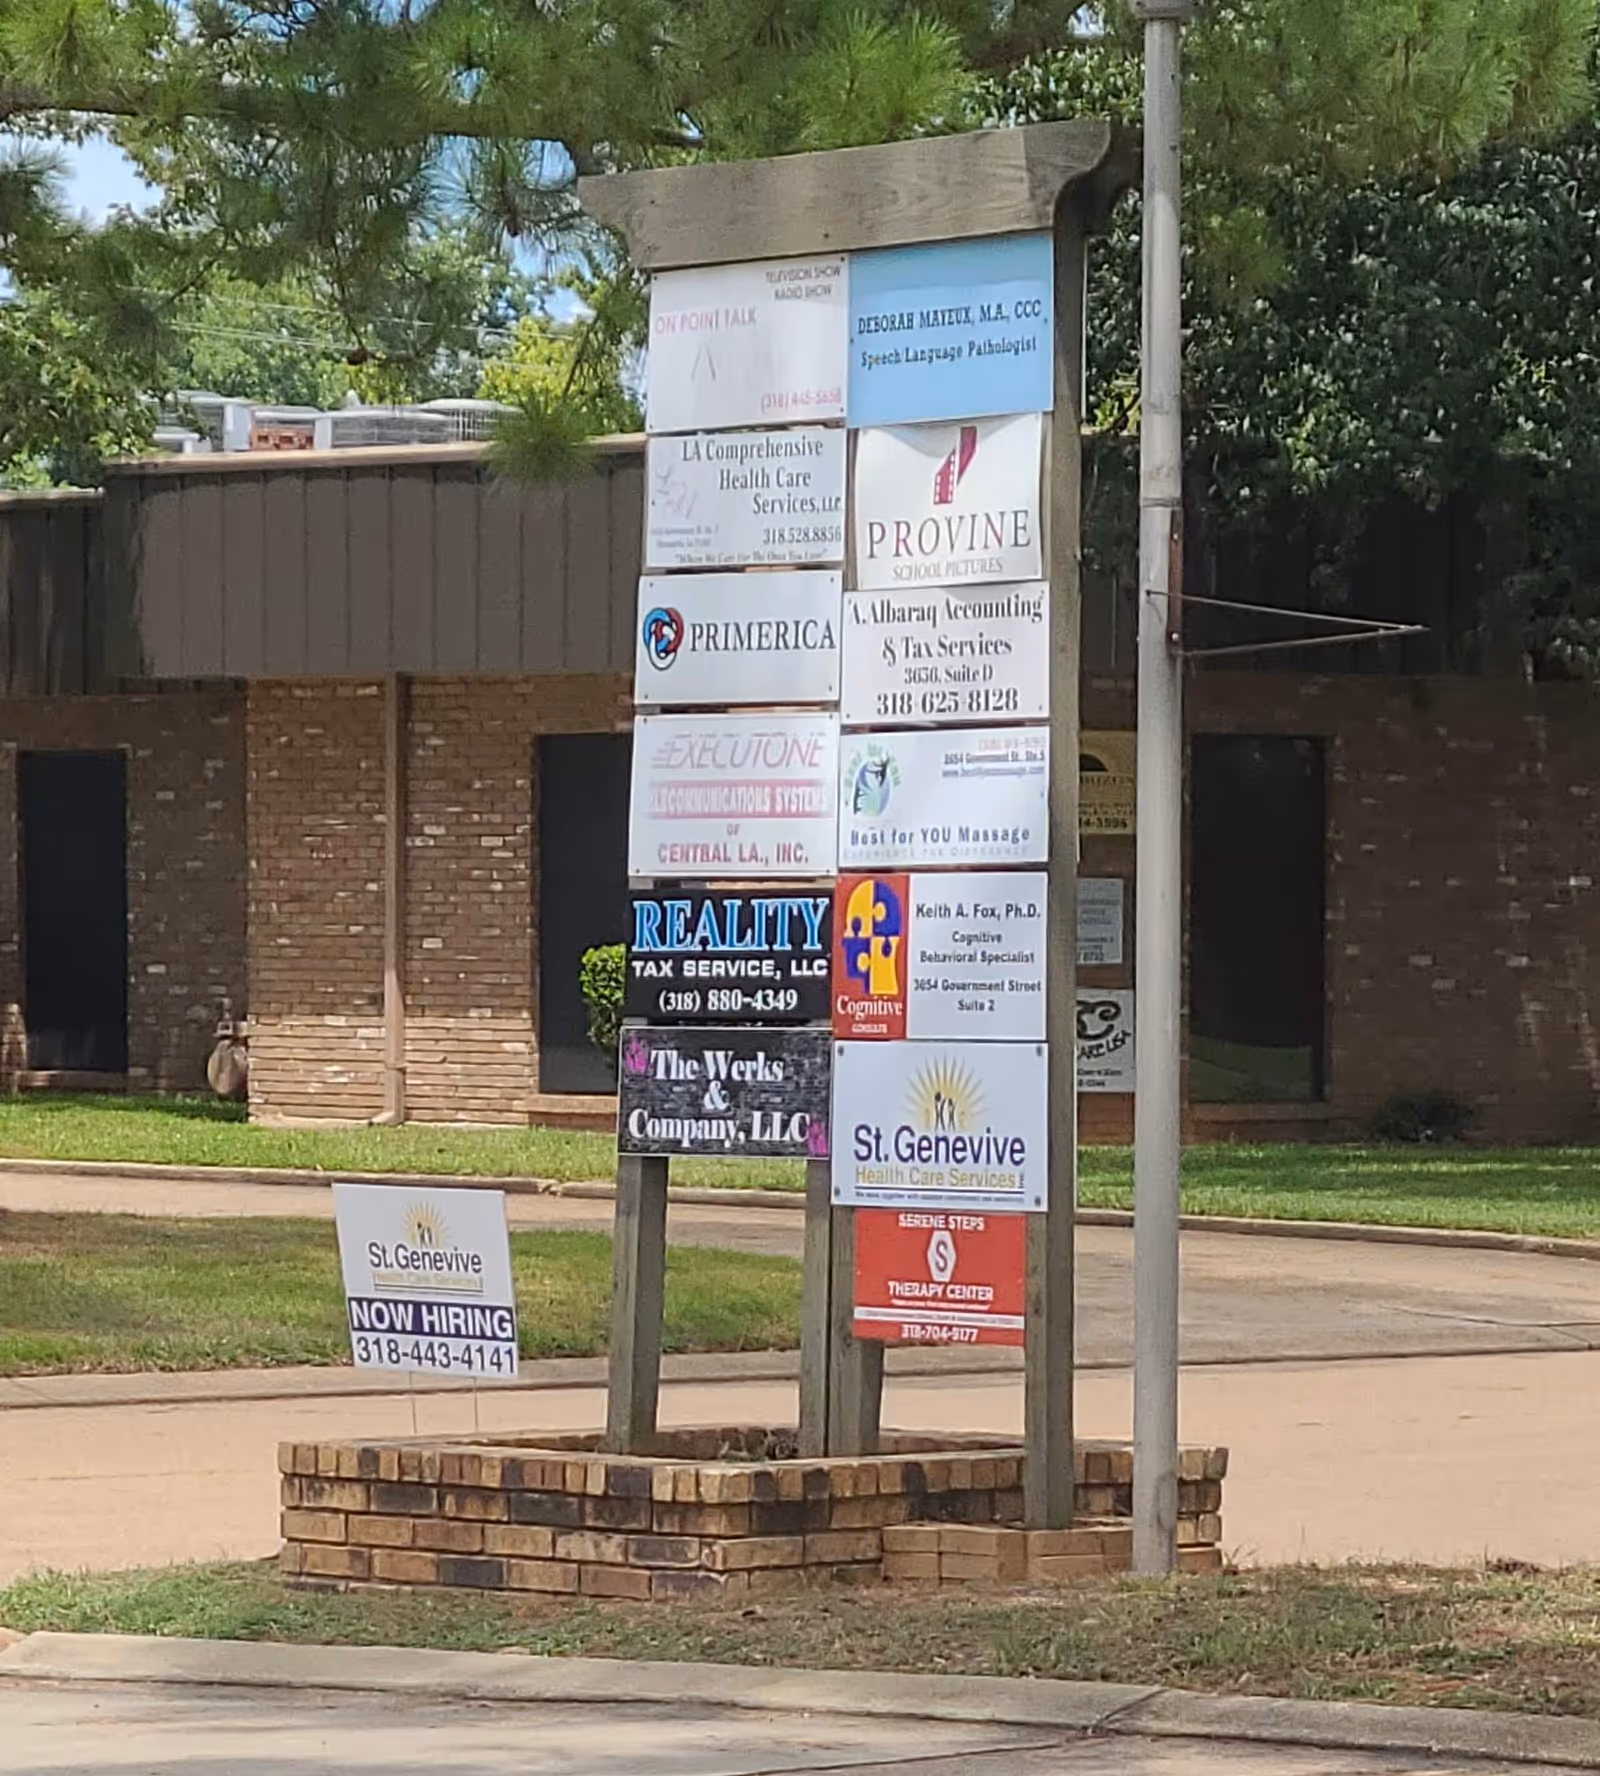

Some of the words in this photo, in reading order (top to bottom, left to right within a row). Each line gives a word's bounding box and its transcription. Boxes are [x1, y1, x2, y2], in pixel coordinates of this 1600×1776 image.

[766, 267, 813, 284] TELEVISION
[814, 265, 842, 279] SHOW
[774, 286, 803, 300] RADIO
[804, 284, 832, 298] SHOW
[654, 315, 676, 335] ON
[681, 309, 720, 332] POINT
[724, 306, 758, 329] TALK
[858, 311, 915, 335] DEBORAH
[919, 306, 975, 328] MAYEUX,
[1014, 299, 1042, 319] CCC
[967, 335, 1037, 358] Pathologist
[682, 440, 702, 463] LA
[706, 435, 824, 466] Comprehensive
[719, 467, 770, 491] Health
[776, 466, 812, 489] Care
[763, 526, 842, 547] 318.528.8856
[867, 509, 1032, 560] PROVINE
[893, 561, 942, 581] SCHOOL
[944, 557, 1004, 578] PICTURES
[943, 593, 1043, 624] Accounting
[690, 618, 837, 652] PRIMERICA
[882, 635, 898, 668] &
[901, 635, 934, 660] Tax
[937, 631, 1013, 659] Services
[944, 663, 980, 685] Suite
[982, 663, 994, 682] D
[876, 687, 1019, 716] 318-625-8128
[653, 731, 826, 770] EXECUTONE
[726, 823, 741, 836] OF
[891, 828, 915, 845] for
[920, 826, 951, 843] YOU
[957, 826, 1030, 845] Massage
[657, 842, 732, 865] CENTRAL
[776, 842, 809, 865] INC.
[631, 897, 830, 952] REALITY
[916, 903, 951, 918] Keith
[955, 903, 969, 918] A.
[973, 903, 1001, 921] Fox,
[1005, 903, 1041, 918] Ph.D.
[952, 931, 1003, 946] Cognitive
[631, 960, 674, 978] TAX
[683, 959, 782, 980] SERVICE,
[790, 958, 829, 976] LLC
[920, 951, 978, 964] Behavioral
[980, 951, 1035, 966] Specialist
[941, 978, 1006, 992] Government
[1007, 978, 1041, 992] Street
[658, 989, 701, 1013] (318)
[707, 988, 799, 1011] 880-4349
[836, 994, 903, 1021] Cognitive
[957, 999, 985, 1012] Suite
[987, 999, 996, 1012] 2
[650, 1049, 700, 1080] The
[702, 1050, 785, 1082] Werks
[703, 1080, 730, 1110] &
[628, 1108, 746, 1149] Company,
[751, 1110, 811, 1142] LLC
[854, 1123, 889, 1163] St.
[893, 1124, 1027, 1167] Genevive
[855, 1164, 905, 1185] Health
[909, 1166, 945, 1187] Care
[949, 1167, 1017, 1189] Services
[898, 1213, 947, 1229] SERENE
[948, 1215, 985, 1232] STEPS
[367, 1241, 394, 1270] St.
[394, 1243, 483, 1275] Genevive
[934, 1239, 949, 1273] S
[888, 1280, 944, 1300] THERAPY
[945, 1283, 994, 1302] CENTER
[349, 1300, 414, 1332] NOW
[420, 1304, 514, 1340] HIRING
[356, 1335, 516, 1374] 318-443-4141
